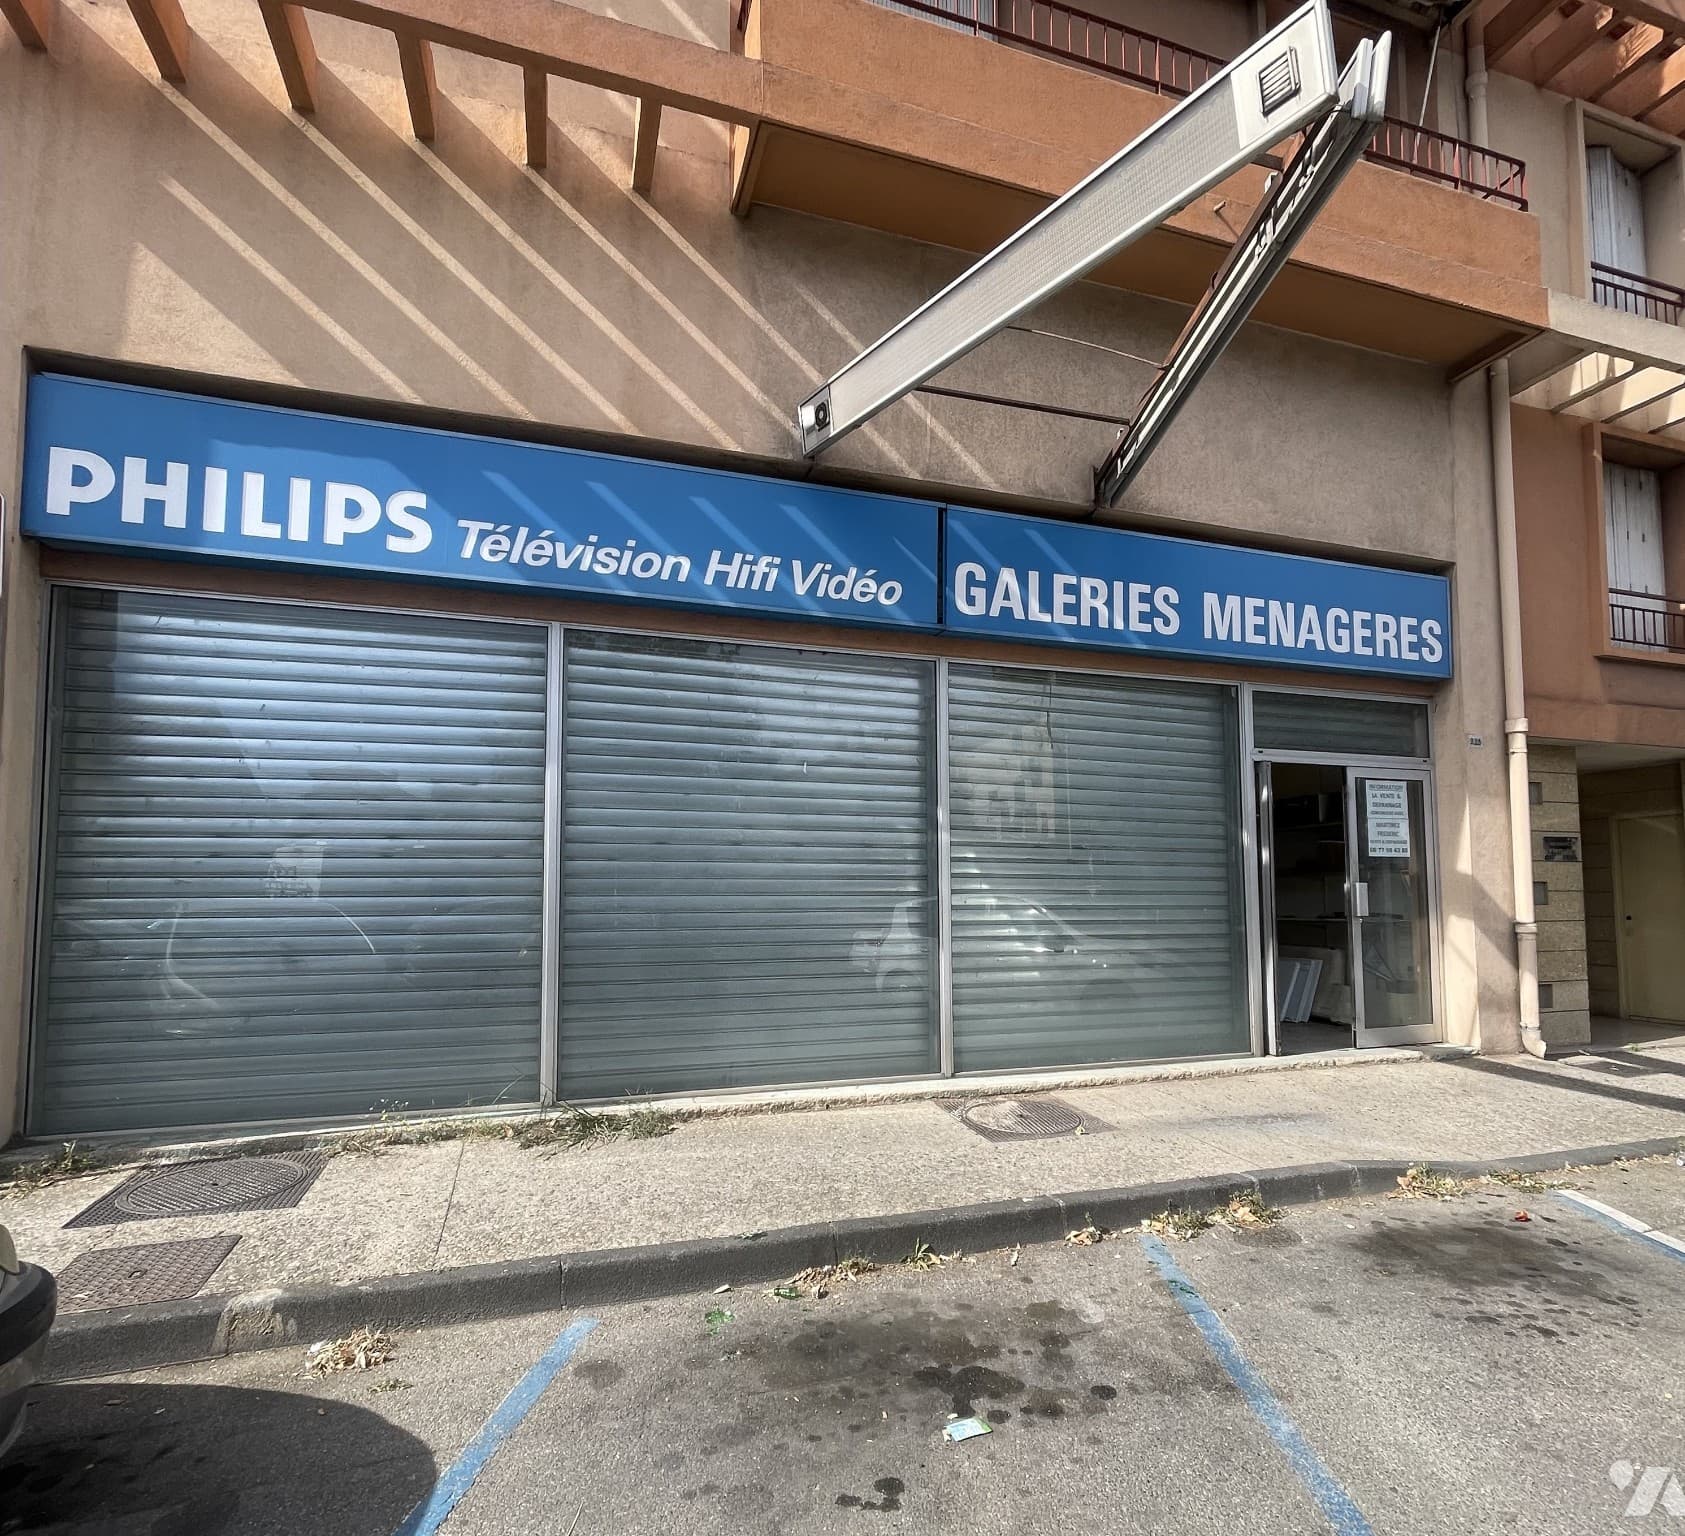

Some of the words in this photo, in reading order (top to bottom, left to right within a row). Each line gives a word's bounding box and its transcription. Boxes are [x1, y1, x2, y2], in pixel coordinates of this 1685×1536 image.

[46, 446, 433, 553] PHILIPS
[457, 519, 691, 583] Télévision
[704, 549, 781, 592] Hifi
[791, 559, 903, 606] Vidéo
[954, 562, 1181, 635] GALERIES
[1203, 591, 1444, 664] MENAGERES
